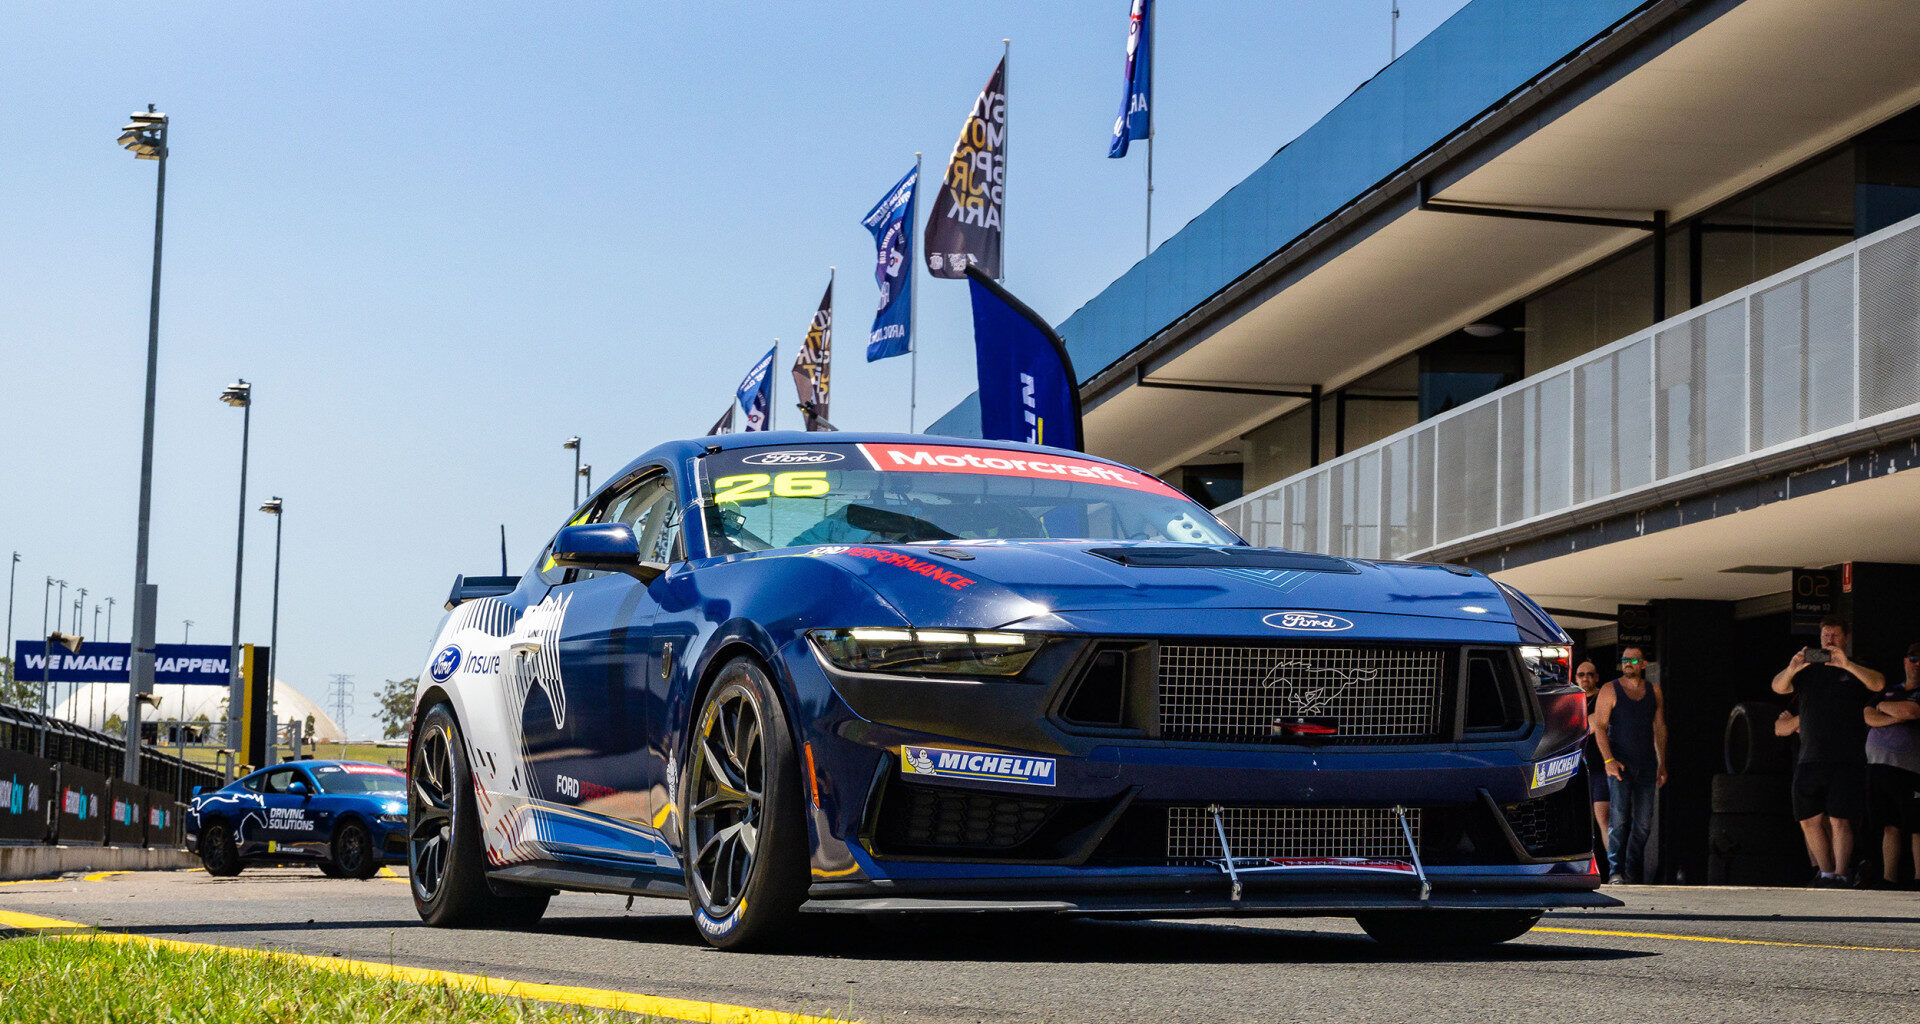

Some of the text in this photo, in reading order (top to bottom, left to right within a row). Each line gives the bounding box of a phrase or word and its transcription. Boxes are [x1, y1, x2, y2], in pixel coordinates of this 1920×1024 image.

[761, 452, 826, 464] Ford
[715, 471, 830, 504] 26
[840, 546, 977, 591] PERFORMANCE
[1797, 575, 1831, 597] 02
[1795, 602, 1821, 612] Garage
[1281, 613, 1337, 629] Ford
[24, 654, 61, 670] WE
[63, 655, 124, 671] MAKE
[433, 649, 501, 676] Ford Insure
[938, 752, 1053, 778] MICHELIN
[1546, 752, 1582, 778] MICHELIN
[556, 774, 579, 799] FORD
[268, 818, 315, 831] SOLUTIONS
[269, 807, 305, 820] DRIVING
